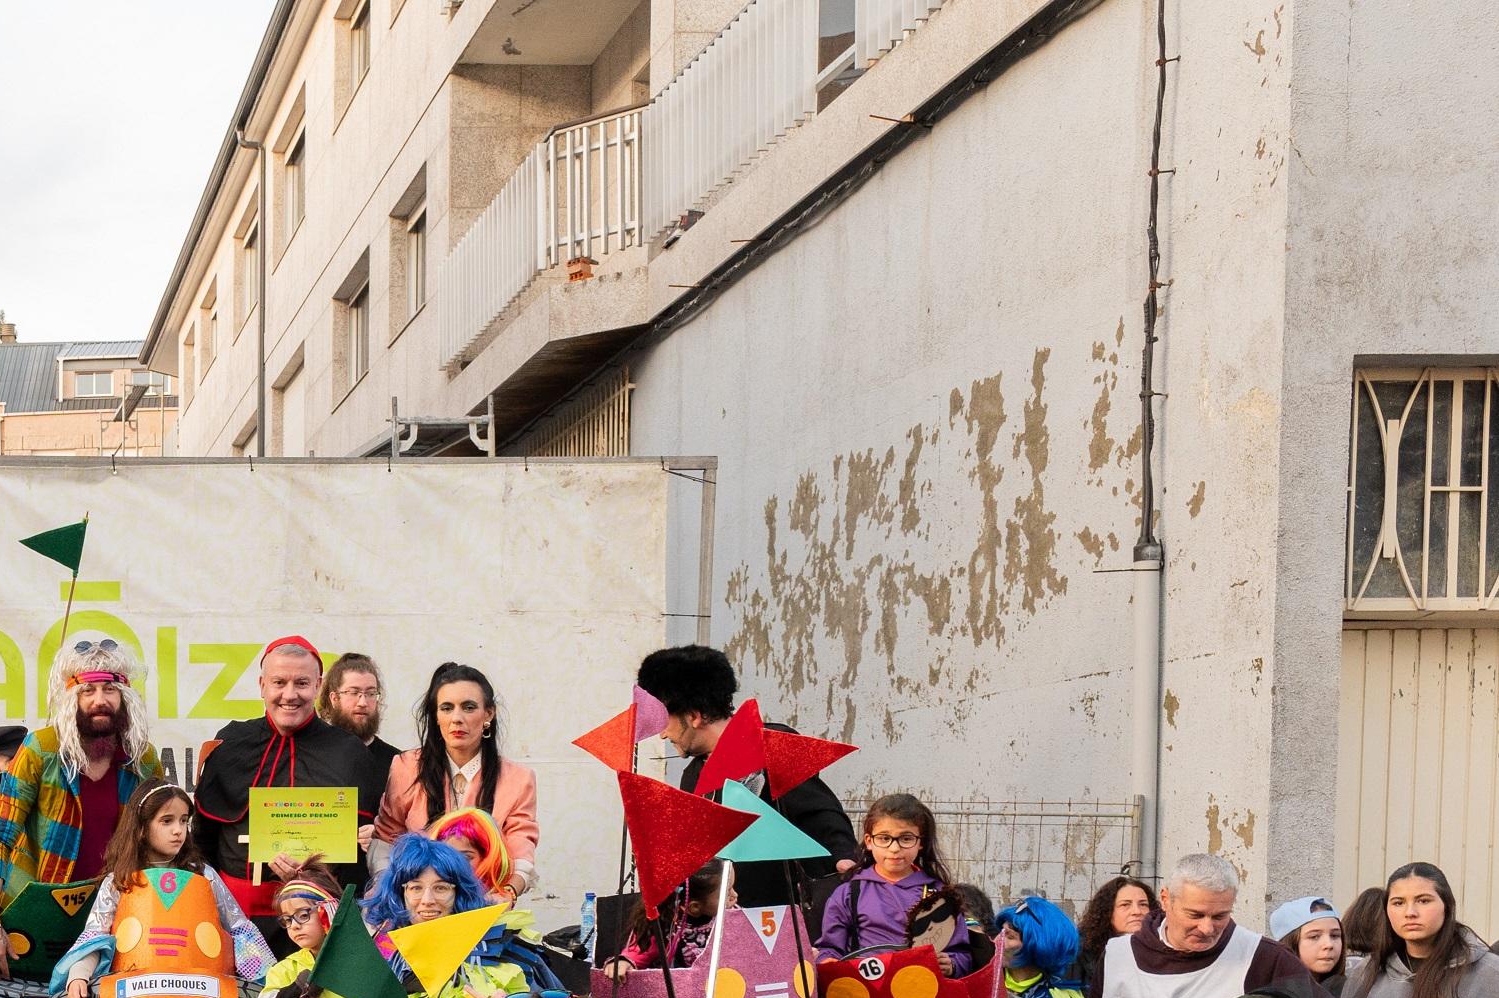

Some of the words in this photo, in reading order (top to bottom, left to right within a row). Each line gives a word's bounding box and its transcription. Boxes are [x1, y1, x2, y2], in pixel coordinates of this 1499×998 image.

[159, 871, 177, 893] 6
[761, 911, 776, 936] 5
[859, 959, 881, 977] 16
[132, 979, 157, 991] VALEI
[161, 979, 207, 991] CHOQUES
